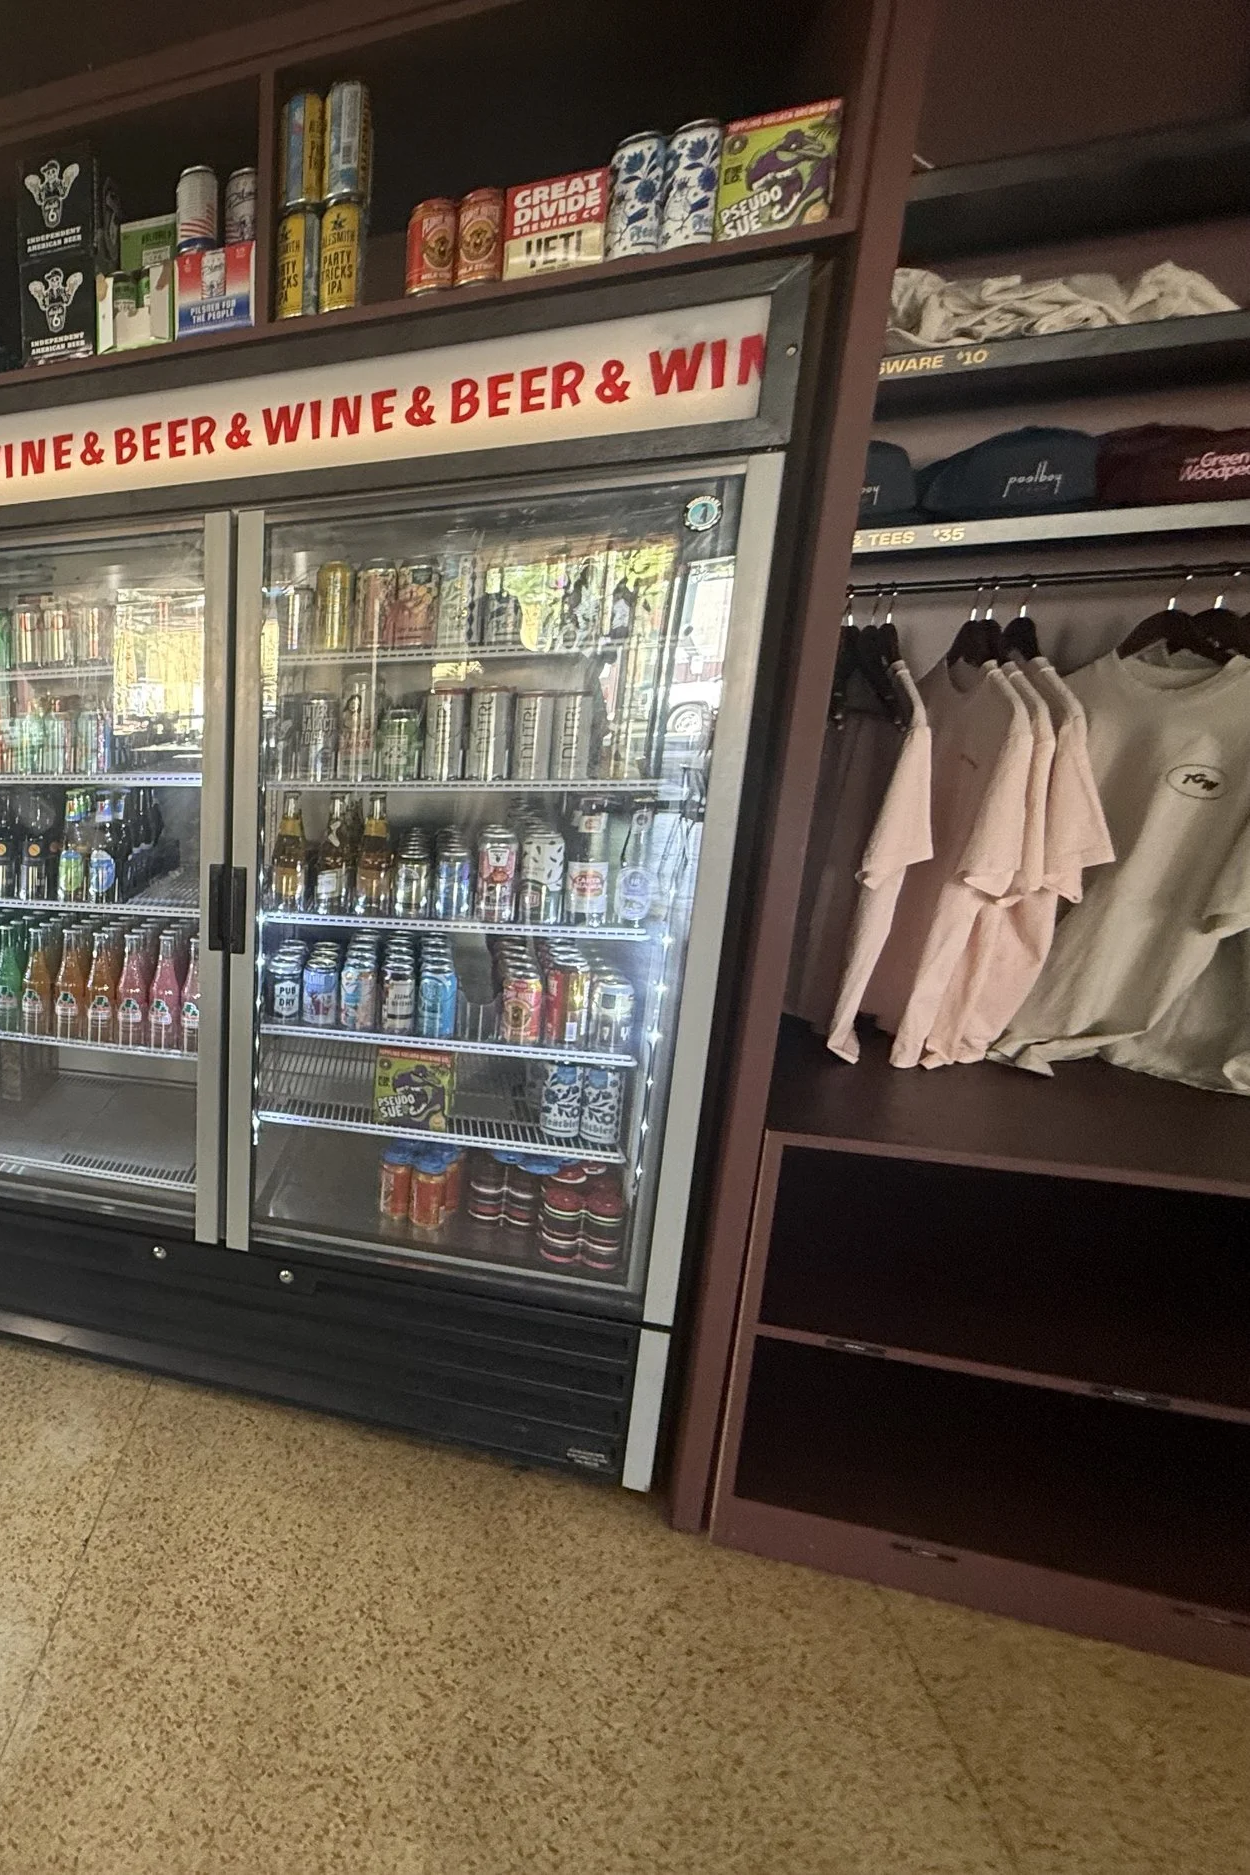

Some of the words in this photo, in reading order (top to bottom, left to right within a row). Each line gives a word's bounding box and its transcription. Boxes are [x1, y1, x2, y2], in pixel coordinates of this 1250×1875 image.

[513, 171, 602, 209] GREAT
[513, 187, 602, 227] DIVIDE
[720, 185, 782, 224] PSEUDO
[48, 209, 57, 222] 6
[512, 212, 578, 237] BREWING
[582, 206, 600, 219] CO
[724, 209, 763, 240] SUE
[26, 225, 82, 245] INDEPENDENT
[26, 238, 62, 253] AMERICAN
[63, 233, 83, 245] BEER
[524, 229, 583, 269] YETI
[323, 250, 352, 268] PARTY
[321, 264, 354, 285] TRICKS
[327, 279, 343, 296] IPA
[190, 301, 220, 316] PILSNER
[221, 299, 237, 310] FOR
[192, 314, 206, 325] THE
[207, 307, 235, 322] PEOPLE
[52, 314, 61, 327] 6
[30, 331, 85, 348] INDEPENDENT
[31, 343, 66, 355] AMERICAN
[67, 339, 86, 349] BEER
[956, 349, 990, 366] $10
[79, 431, 105, 466] &
[114, 415, 217, 466] BEER
[224, 411, 253, 450] &
[261, 388, 397, 446] WINE
[404, 385, 437, 427] &
[450, 360, 586, 425] BEER
[594, 359, 631, 405] &
[1200, 451, 1250, 468] Green
[1002, 460, 1063, 498] poolboy
[868, 530, 916, 547] TEES
[933, 527, 966, 543] $35
[279, 986, 296, 995] PUB
[278, 998, 295, 1006] DRY
[377, 1093, 416, 1107] PSEUDO
[379, 1105, 404, 1118] SUE
